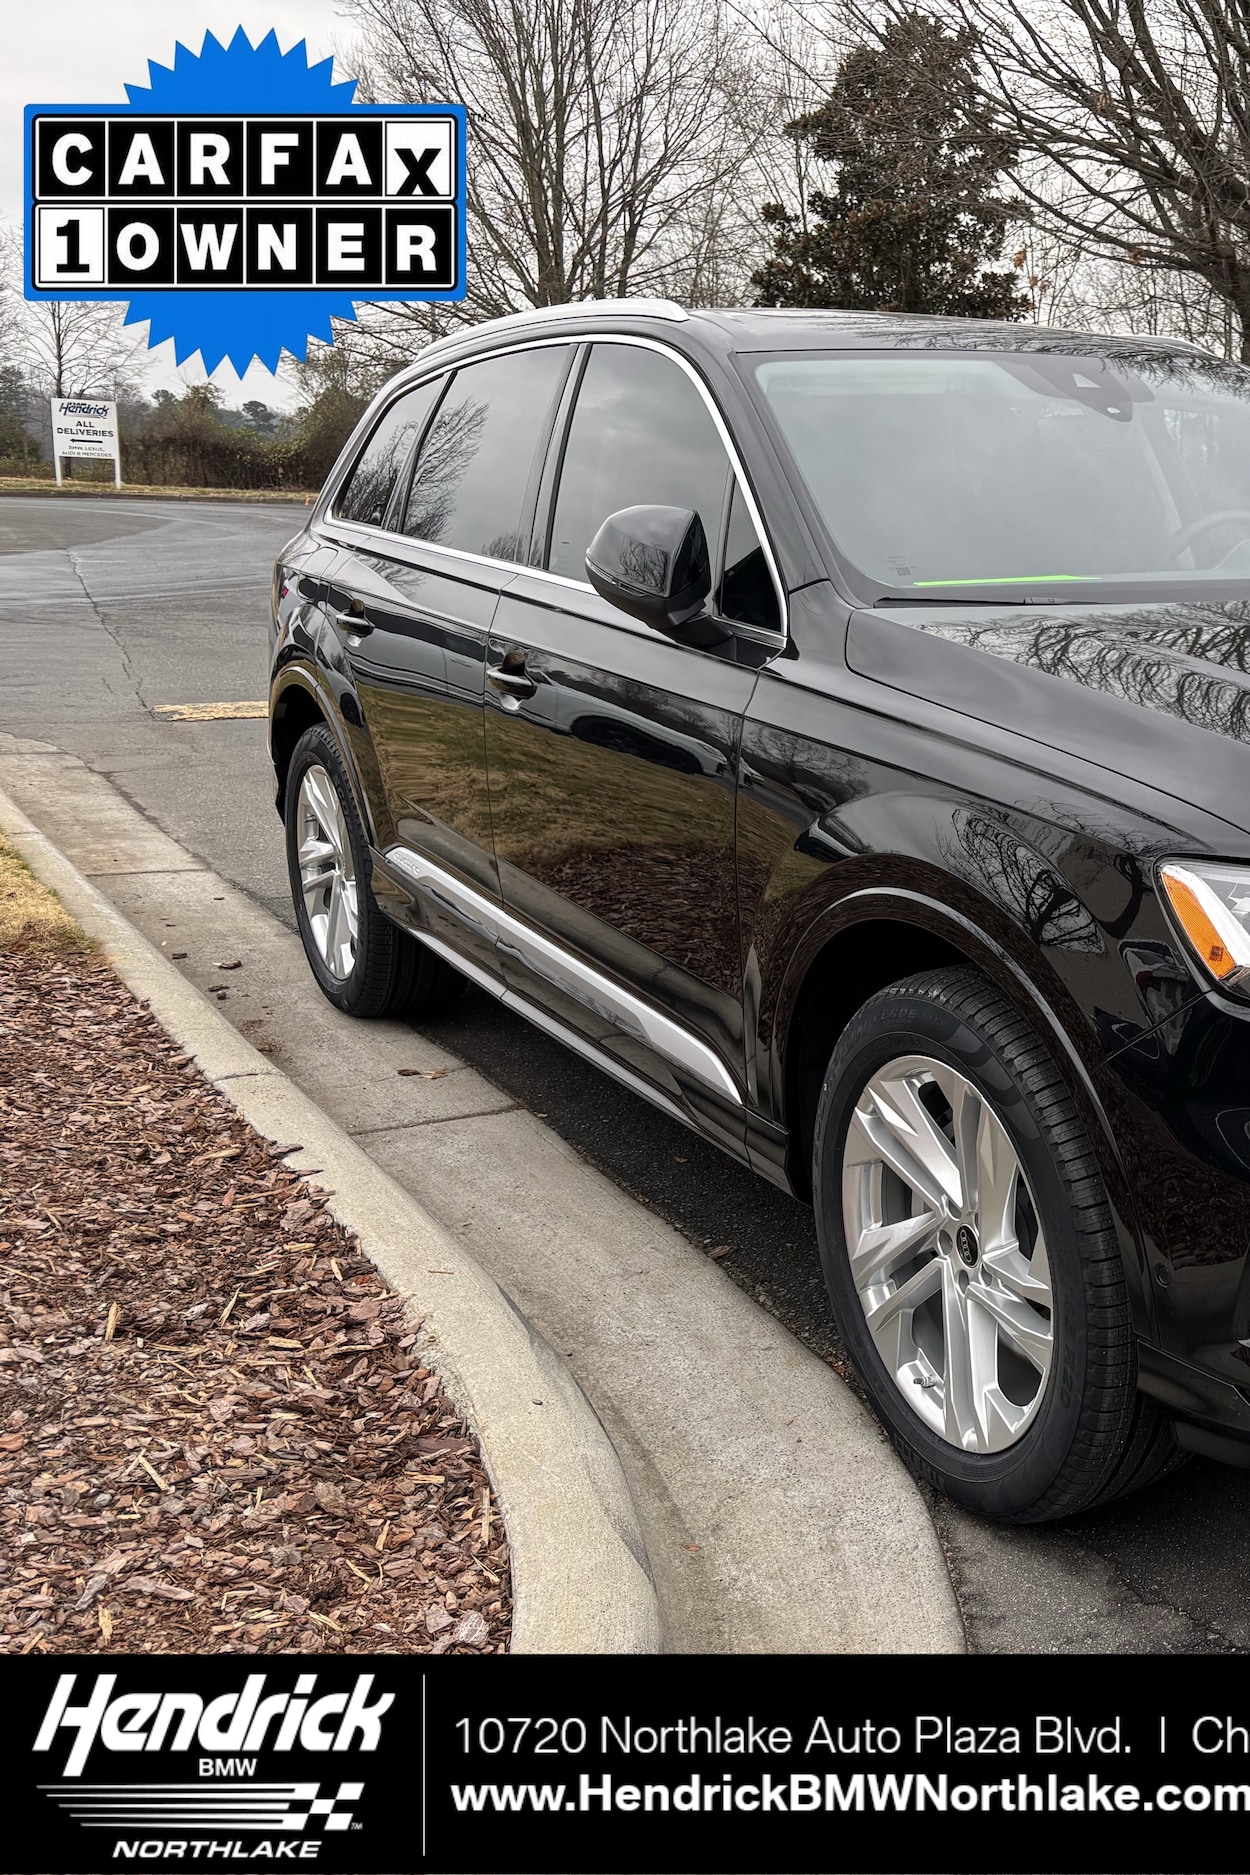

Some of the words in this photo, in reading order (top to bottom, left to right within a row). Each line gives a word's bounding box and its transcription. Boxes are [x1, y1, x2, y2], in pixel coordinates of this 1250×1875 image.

[59, 402, 109, 417] Hendrick
[76, 420, 94, 428] ALL
[57, 427, 114, 437] DELIVERIES
